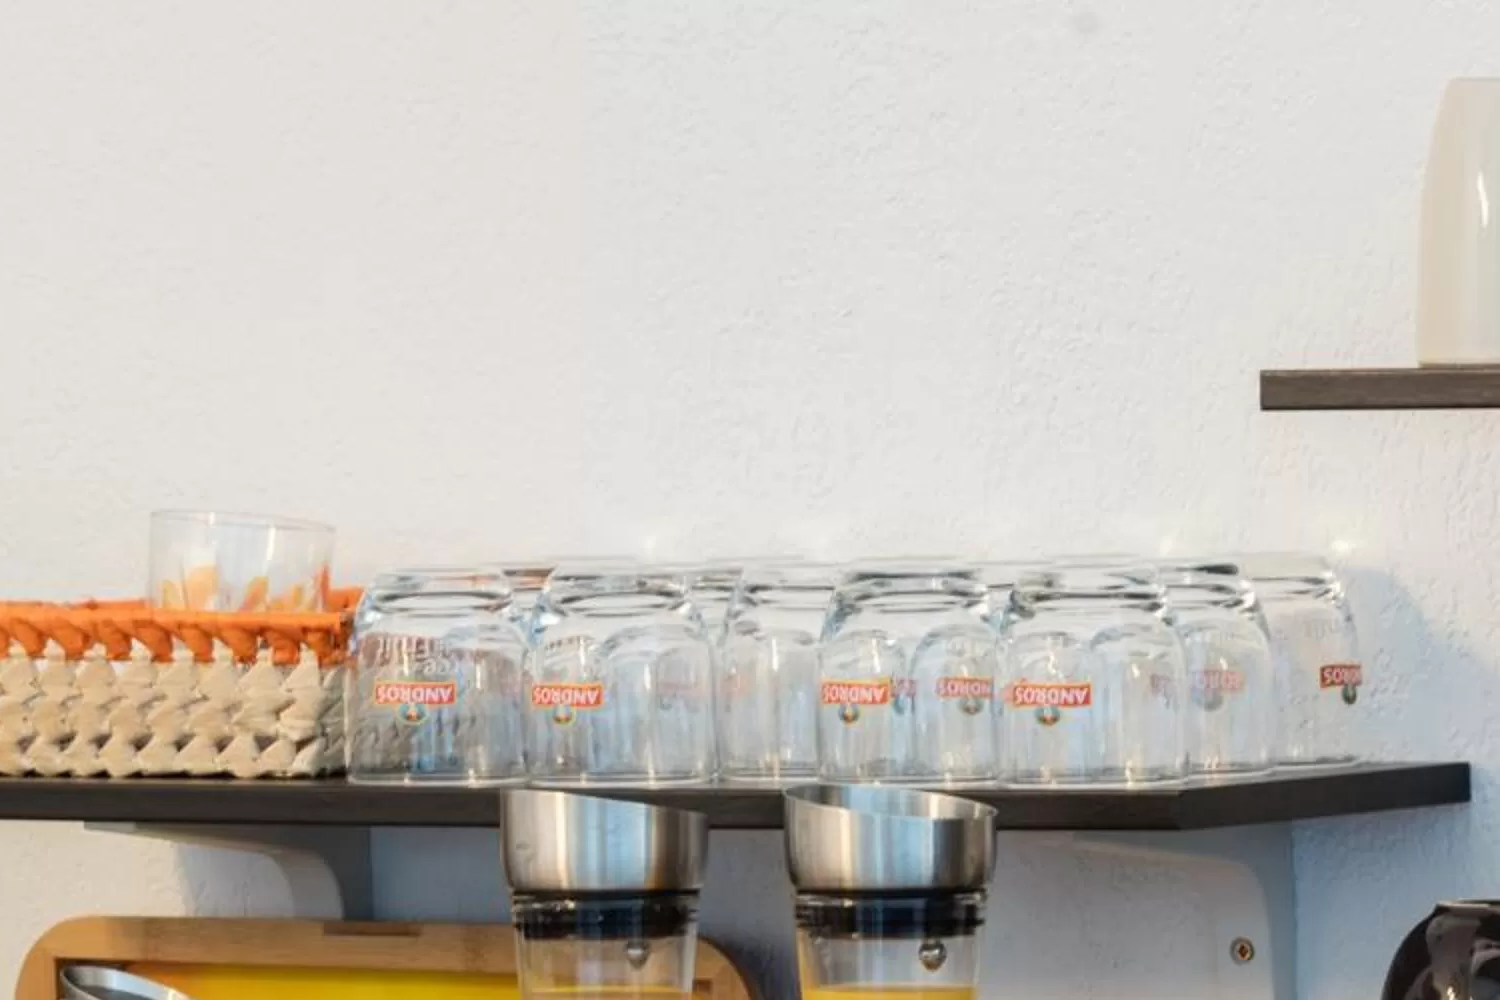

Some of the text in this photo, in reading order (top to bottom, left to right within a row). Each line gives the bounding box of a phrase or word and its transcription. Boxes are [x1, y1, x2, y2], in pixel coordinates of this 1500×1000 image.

[376, 685, 453, 703] ANDROS
[533, 686, 600, 705] ANDROS
[821, 683, 888, 703] ANDROS
[1013, 685, 1089, 705] ANDROS
